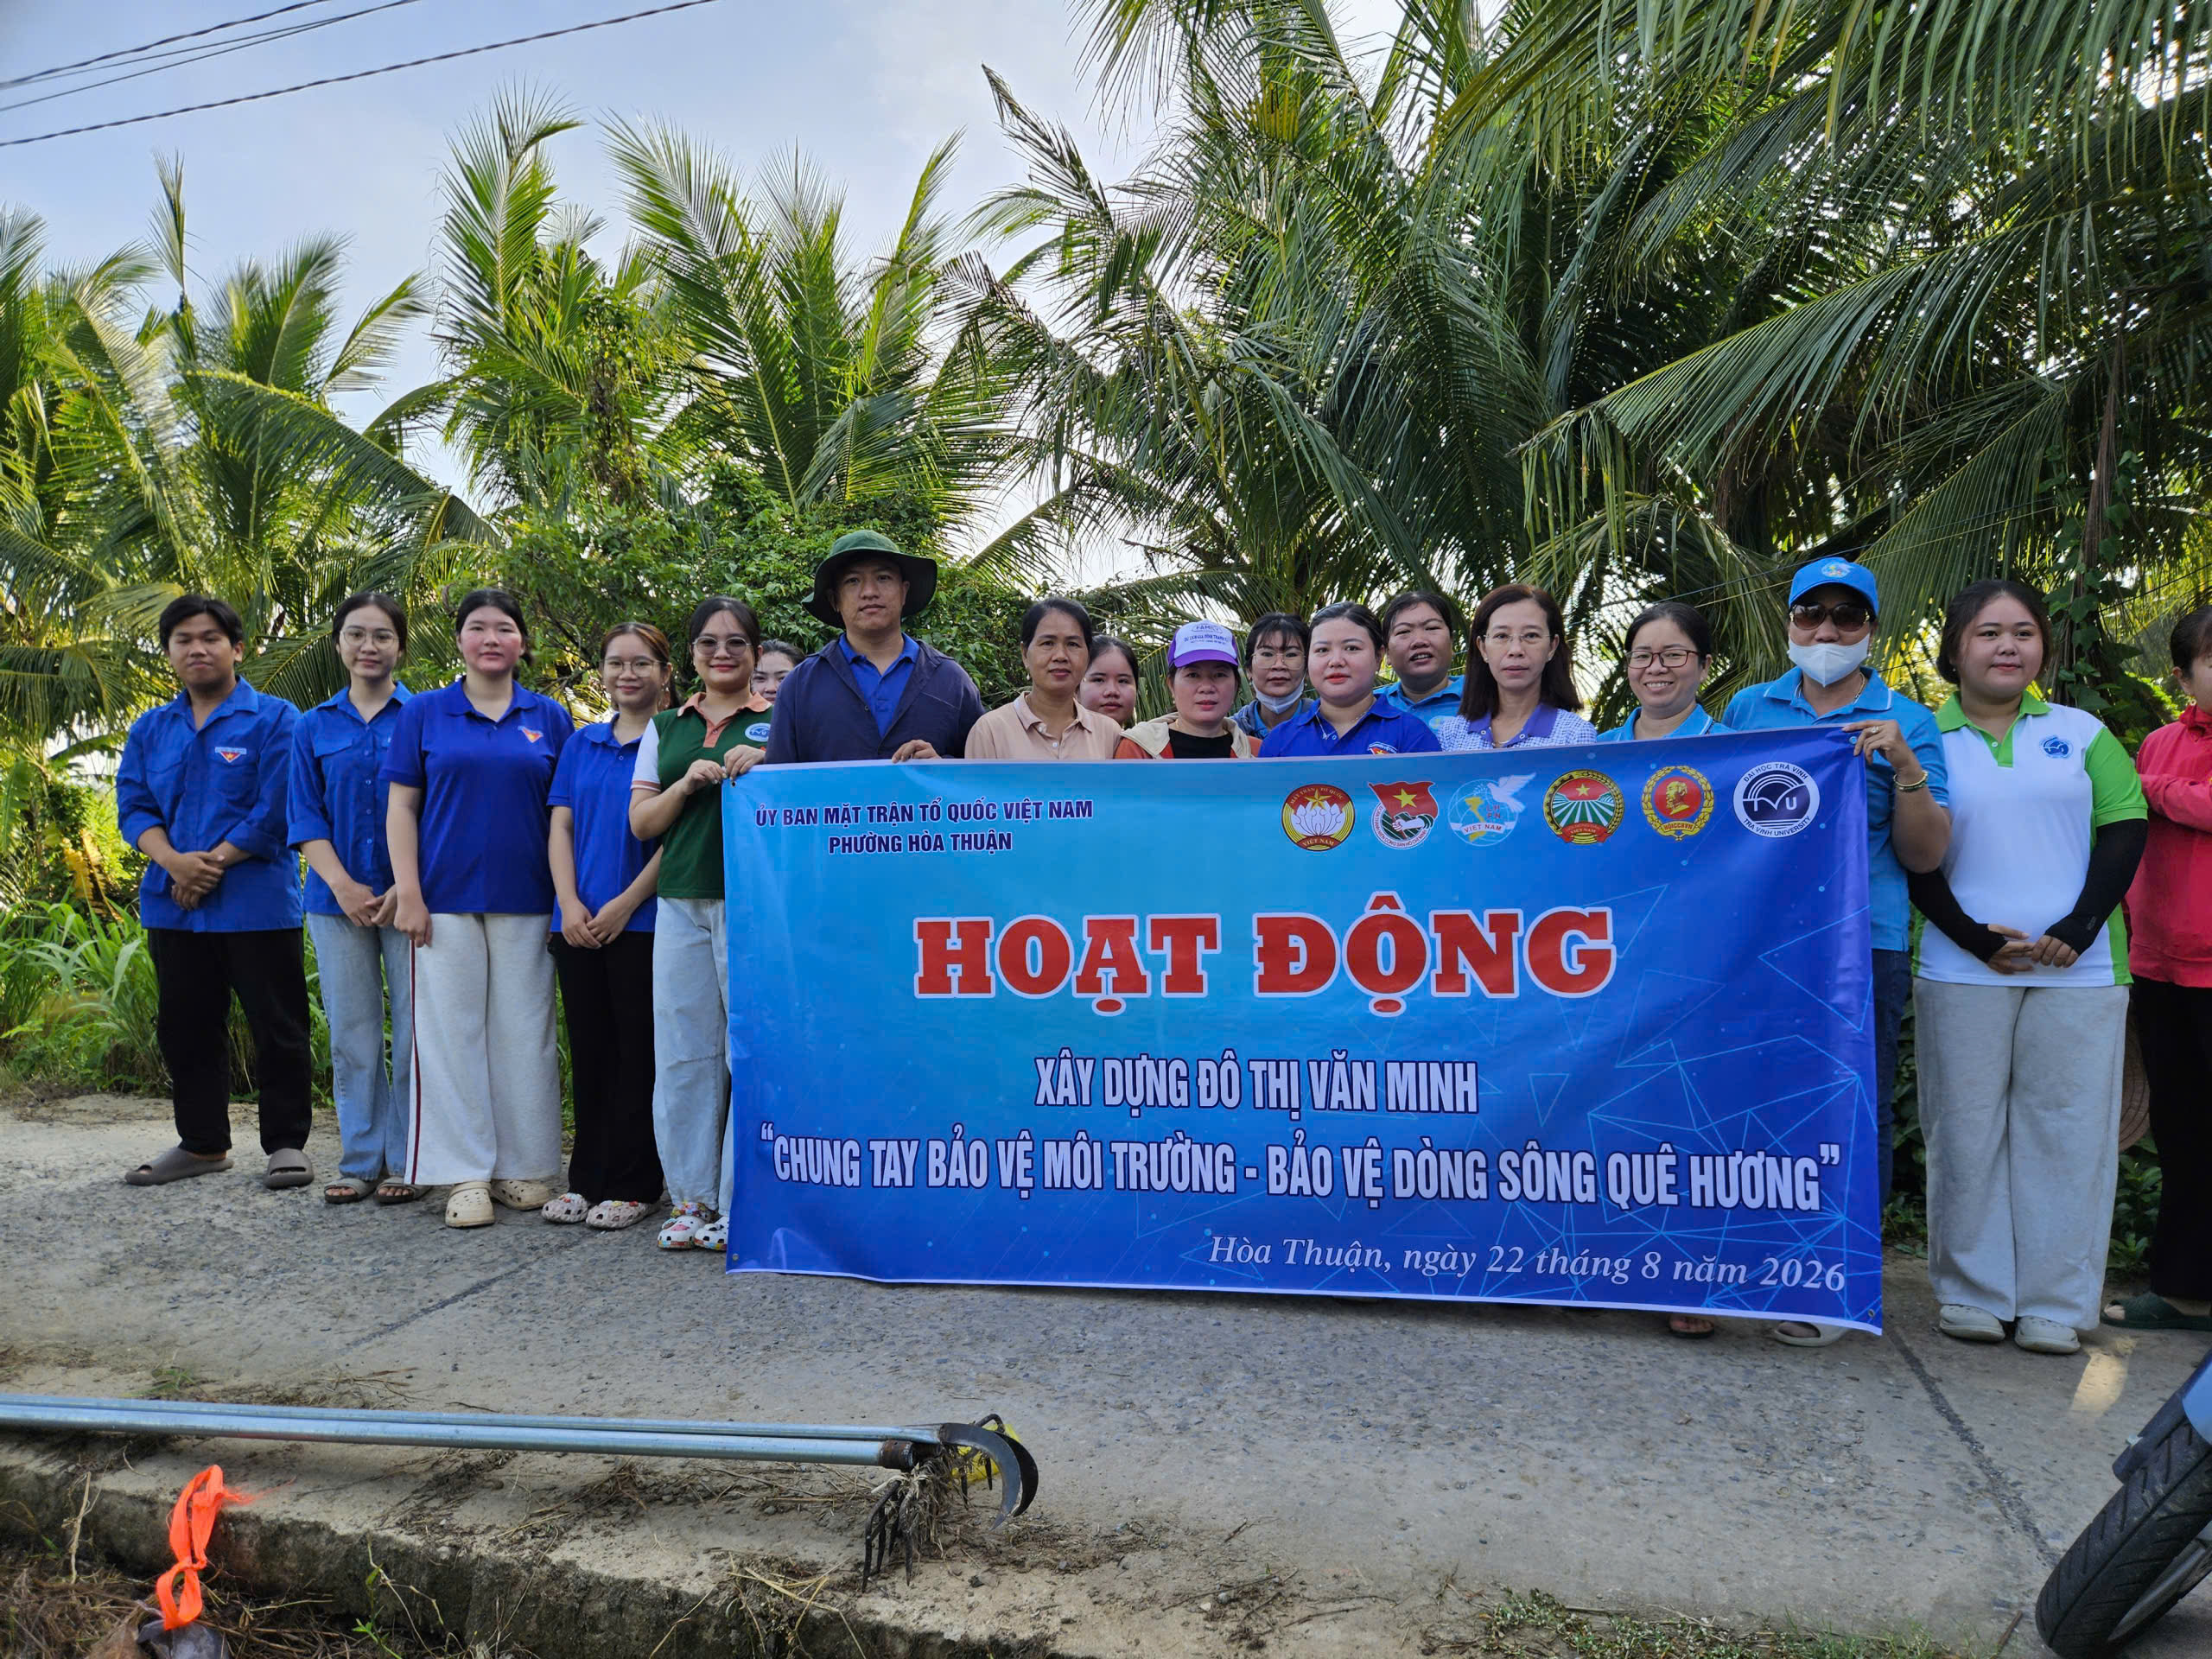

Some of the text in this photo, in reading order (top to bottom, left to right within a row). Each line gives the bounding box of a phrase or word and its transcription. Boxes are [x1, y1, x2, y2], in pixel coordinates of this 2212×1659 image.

[1792, 766, 1808, 780] VINH
[756, 797, 1093, 828] ỦY BAN MẶT TRẬN TỔ QUỐC VIỆT NAM
[1756, 825, 1773, 836] VINH
[1774, 815, 1811, 836] UNIVERSITY
[829, 830, 1012, 855] PHƯỜNG HÒA THUẬN
[914, 891, 1617, 1017] HOẠT ĐỘNG
[1035, 1047, 1478, 1120] XÂY DỰNG ĐÔ THỊ VĂN MINH
[868, 1139, 919, 1188] TAY
[927, 1122, 988, 1188] BẢO
[996, 1129, 1034, 1199] VỆ
[1043, 1129, 1103, 1190] MÔI
[1110, 1130, 1236, 1194] TRƯỜNG
[1267, 1128, 1334, 1197] BẢO
[1341, 1136, 1384, 1210] VỆ
[1392, 1136, 1489, 1200] DÒNG
[1497, 1139, 1599, 1204] SÔNG
[1605, 1141, 1680, 1211] QUÊ
[1209, 1236, 1846, 1292] Hòa Thuận, ngày 22 tháng 8 năm 2026
